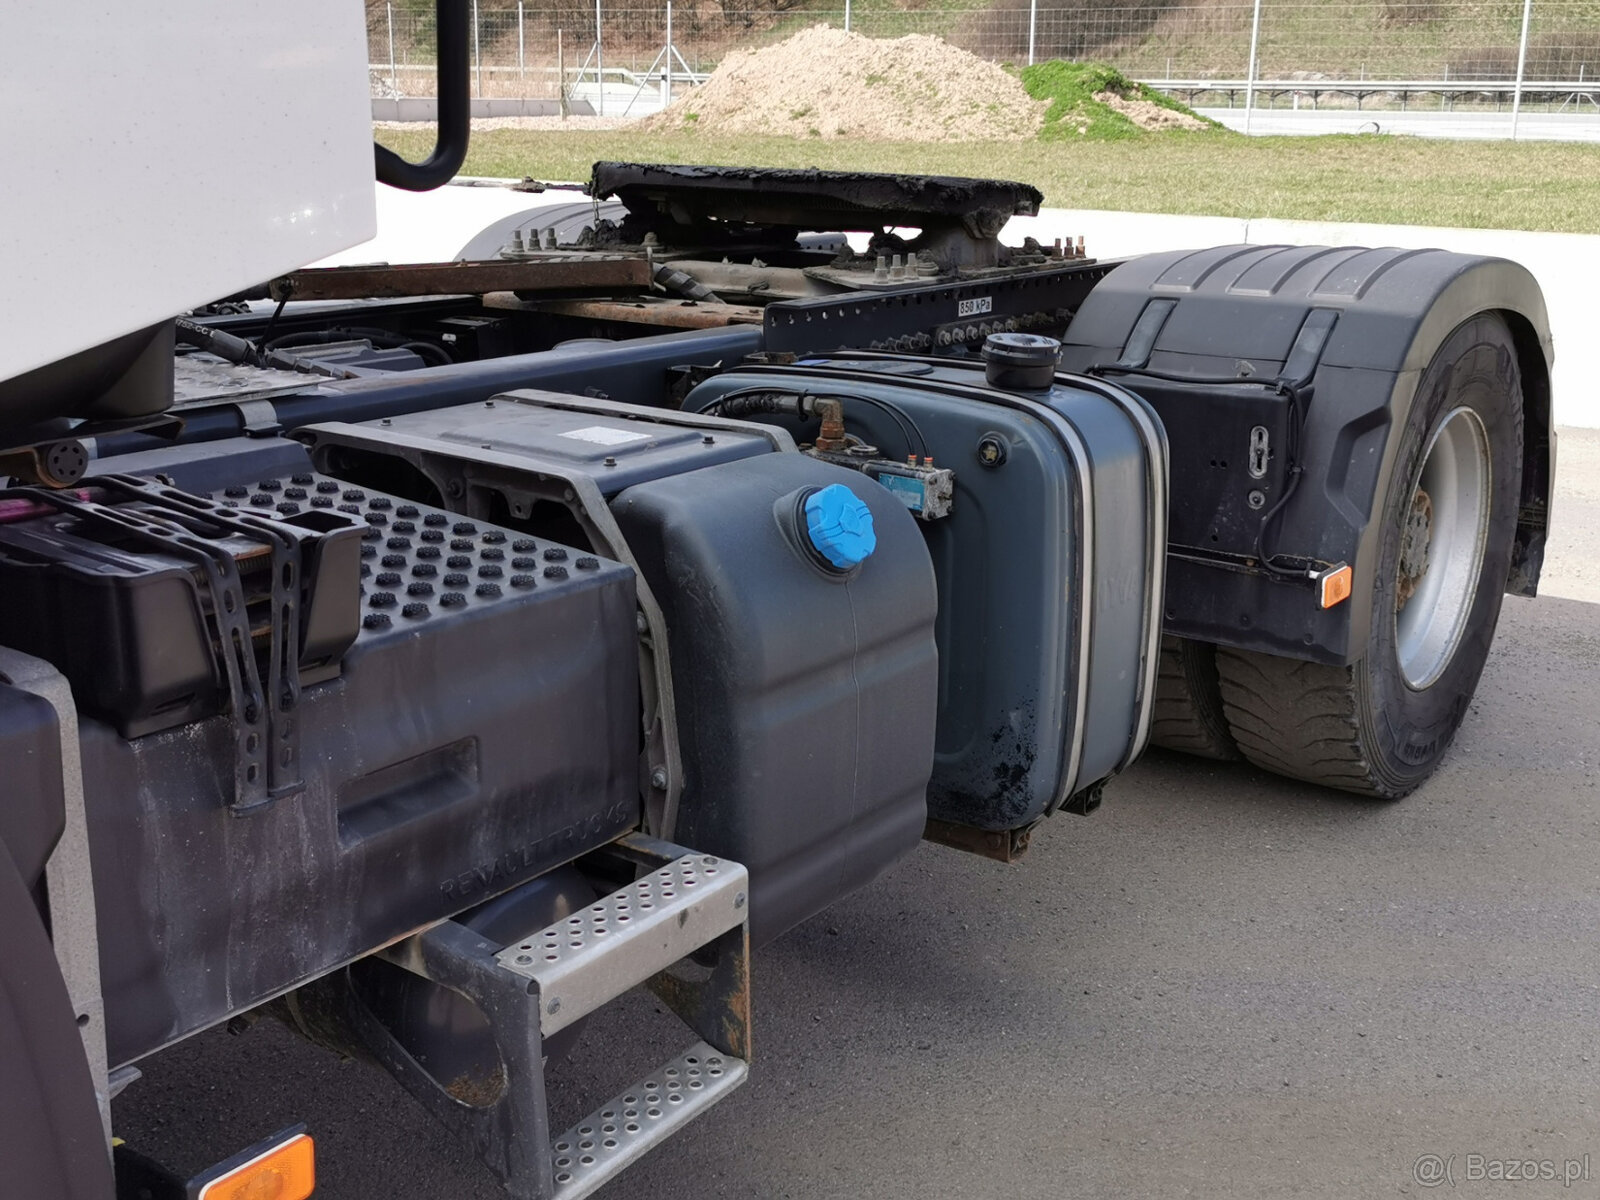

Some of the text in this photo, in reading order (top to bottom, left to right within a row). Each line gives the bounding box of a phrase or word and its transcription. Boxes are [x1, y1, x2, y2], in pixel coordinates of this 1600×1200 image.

[960, 298, 991, 314] 850 kPa
[439, 800, 628, 899] RENAULT TRUCKS
